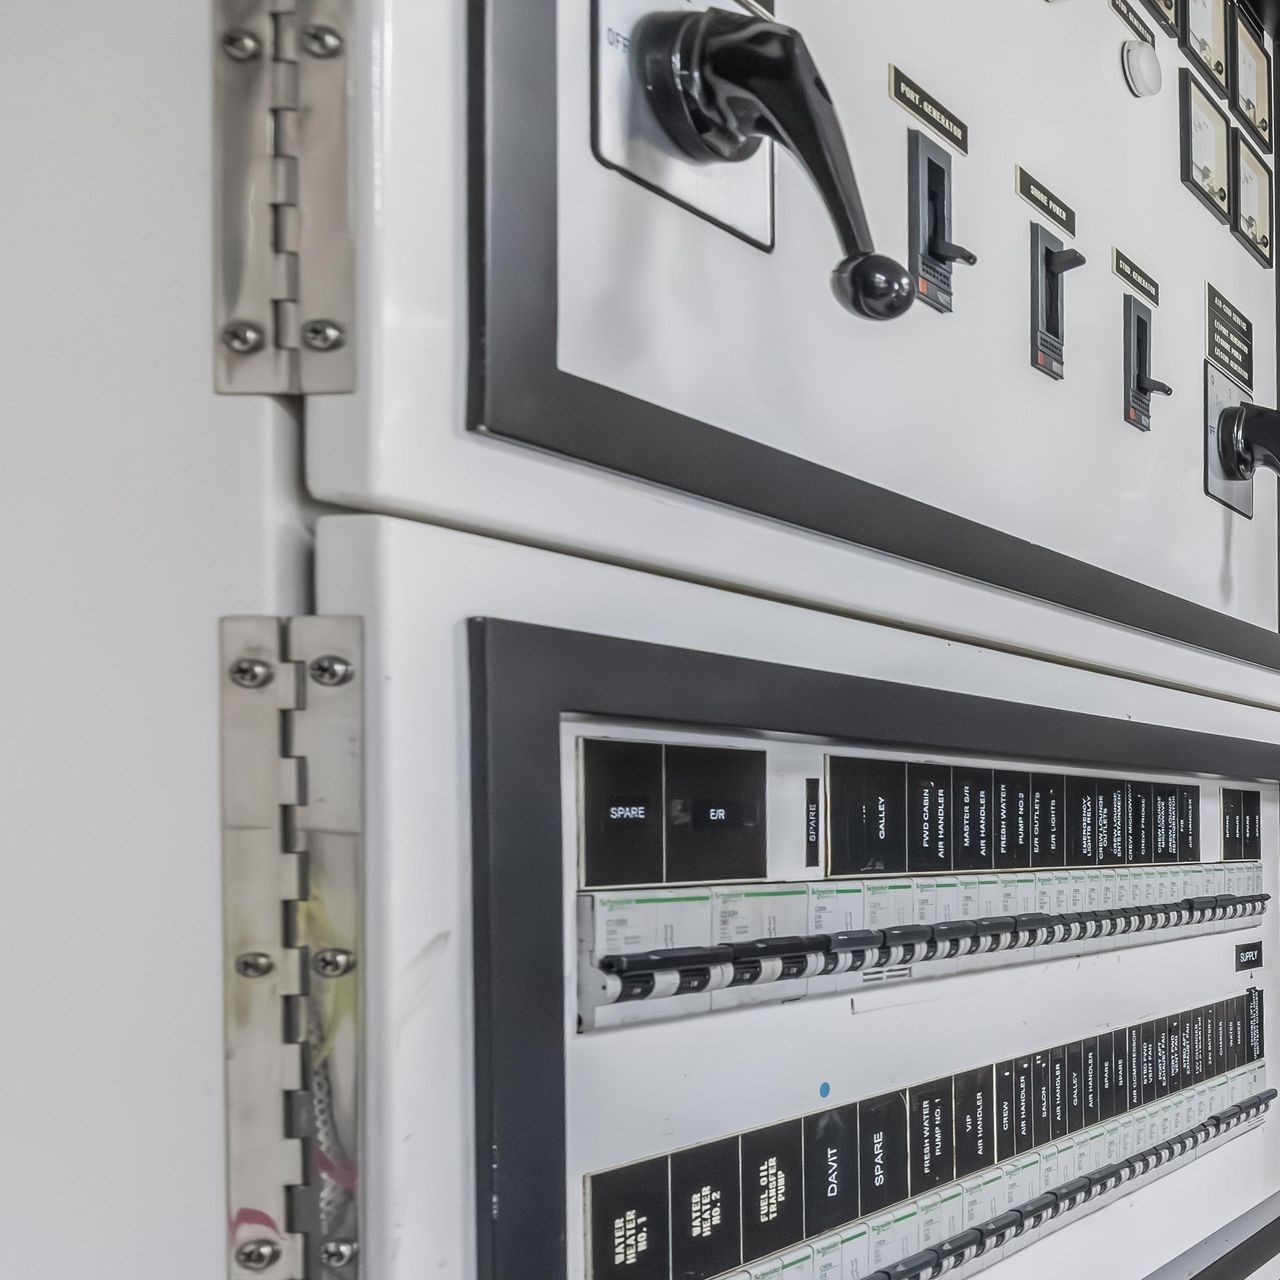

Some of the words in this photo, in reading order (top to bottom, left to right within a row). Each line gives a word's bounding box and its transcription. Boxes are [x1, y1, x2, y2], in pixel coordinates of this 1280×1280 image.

[923, 101, 962, 140] GENERATOR
[1030, 185, 1048, 206] SHORE
[1049, 200, 1067, 221] POWER
[610, 807, 645, 818] SPARE
[710, 809, 725, 820] E/R
[1240, 951, 1258, 962] SUPPLY
[760, 1161, 768, 1186] OIL
[827, 1146, 838, 1197] DAVIT
[874, 1132, 884, 1186] SPARE
[712, 1190, 721, 1200] 2
[769, 1157, 777, 1220] TRANSFER
[637, 1216, 647, 1224] 1
[692, 1193, 701, 1237] WATER
[702, 1185, 711, 1236] HEATER
[712, 1203, 721, 1225] NO.
[760, 1190, 769, 1222] FUEL
[614, 1217, 625, 1264] WATER
[625, 1209, 636, 1264] HEATER
[637, 1228, 647, 1251] NO.
